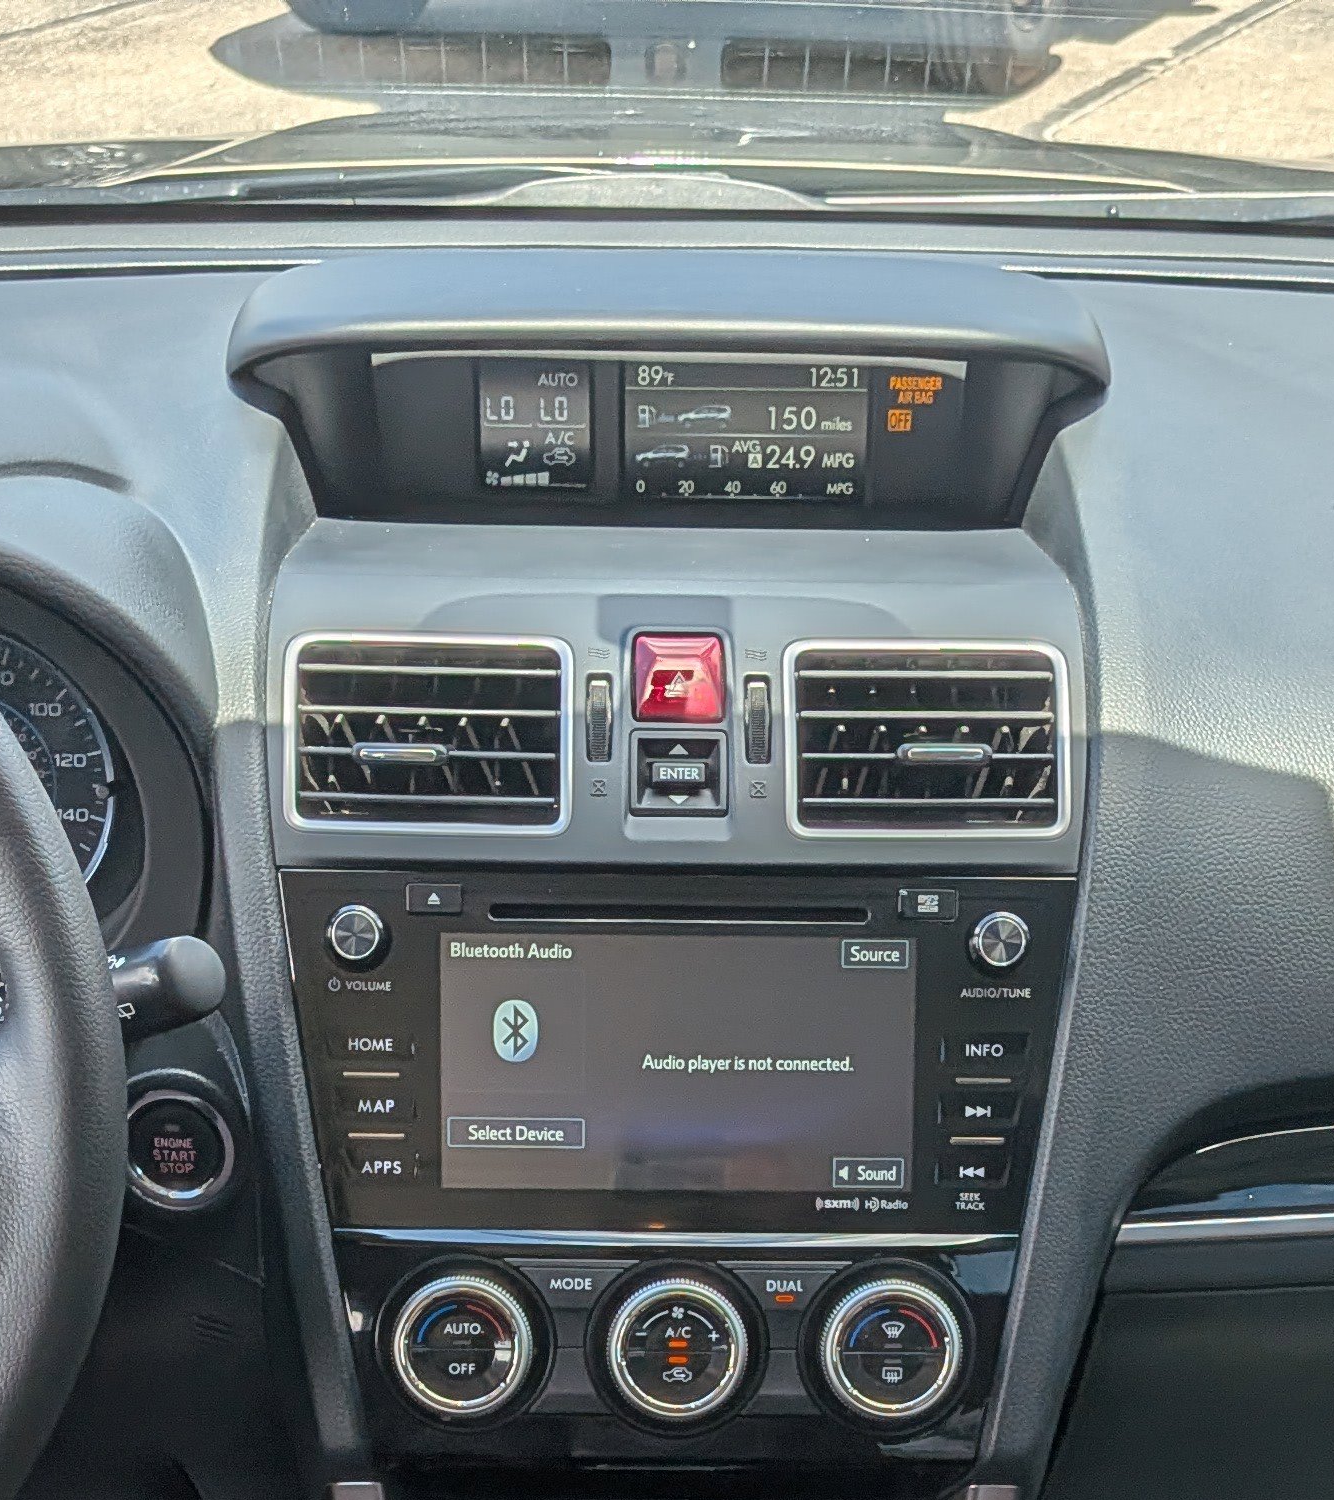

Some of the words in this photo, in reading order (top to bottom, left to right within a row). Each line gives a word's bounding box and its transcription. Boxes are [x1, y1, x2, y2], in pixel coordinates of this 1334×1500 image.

[538, 373, 578, 387] AUTO
[809, 367, 858, 387] 12:51
[889, 376, 943, 391] PASSENGER
[768, 406, 817, 431] 150
[820, 416, 853, 431] miles
[889, 412, 911, 429] OFF
[544, 431, 575, 445] A/C
[731, 440, 762, 453] AVG
[766, 445, 816, 469] 24.9
[821, 452, 855, 469] MPG
[636, 480, 646, 493] 0
[678, 480, 695, 494] 20
[724, 480, 742, 494] 40
[770, 480, 787, 494] 60
[826, 482, 854, 495] MPG
[29, 702, 62, 717] 100
[53, 753, 87, 768] 120
[659, 767, 699, 780] ENTER
[450, 942, 524, 958] Bluetooth
[527, 943, 573, 959] Audio
[850, 946, 900, 962] Source
[345, 981, 392, 992] VOLUME
[960, 987, 1031, 999] AUDIO/TUNE
[348, 1038, 393, 1052] HOME
[965, 1043, 1004, 1057] INFO
[642, 1054, 685, 1070] Audio
[688, 1055, 731, 1074] player
[734, 1056, 746, 1071] is
[748, 1057, 773, 1071] not
[775, 1056, 855, 1072] connected.
[358, 1100, 395, 1113] MAP
[468, 1124, 512, 1141] Select
[515, 1125, 565, 1141] Device
[153, 1137, 194, 1149] ENGINE
[152, 1148, 197, 1161] START
[159, 1162, 195, 1174] STOP
[361, 1160, 402, 1174] APPS
[857, 1165, 896, 1181] Sound
[959, 1192, 981, 1201] SEEK
[881, 1199, 909, 1210] Radio
[955, 1201, 985, 1211] TRACK
[549, 1278, 593, 1290] MODE
[766, 1279, 803, 1292] DUAL
[443, 1323, 482, 1335] AUTO
[664, 1326, 692, 1339] A/C
[448, 1363, 476, 1375] OFF
